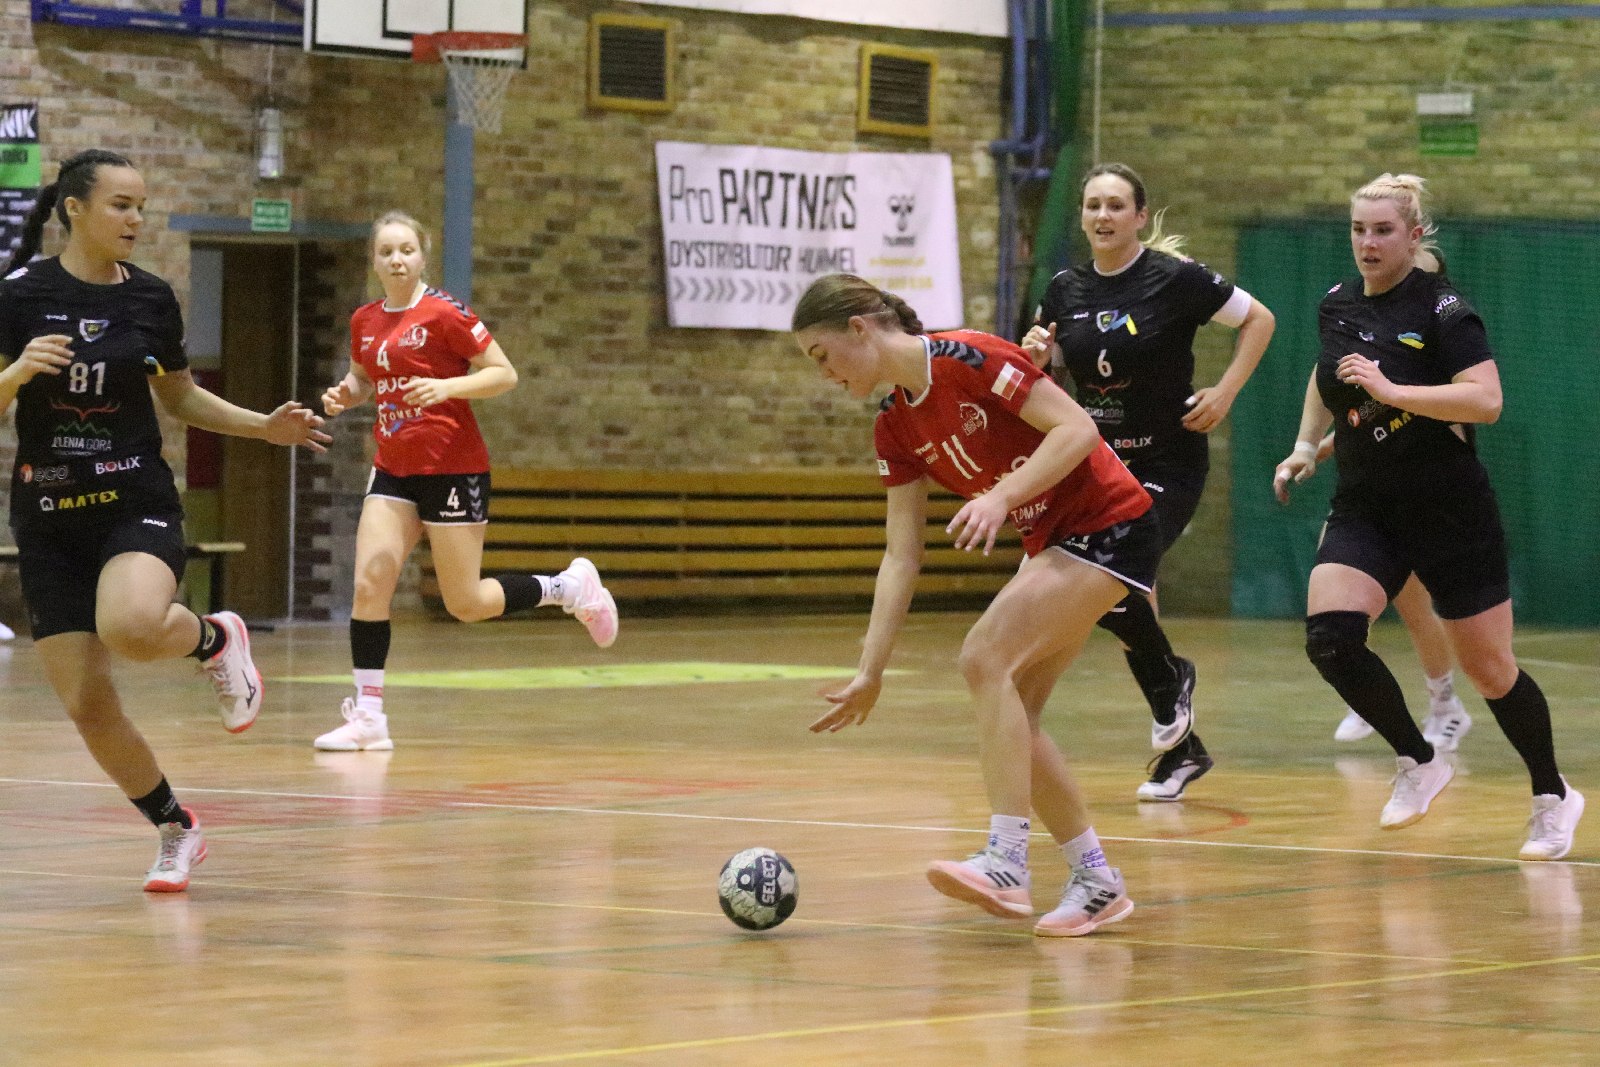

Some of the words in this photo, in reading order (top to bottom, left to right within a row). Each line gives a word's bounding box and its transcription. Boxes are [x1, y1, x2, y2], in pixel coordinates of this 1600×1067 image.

[670, 165, 714, 224] Pro
[1434, 295, 1458, 314] WILD
[377, 340, 391, 371] 4
[1098, 349, 1113, 377] 6
[69, 362, 106, 395] 81
[1114, 435, 1152, 449] BOLIX
[95, 456, 141, 474] BOLIX
[941, 434, 983, 480] 11
[58, 489, 119, 510] MATEX
[446, 487, 460, 510] 4
[761, 856, 777, 904] SELECT
